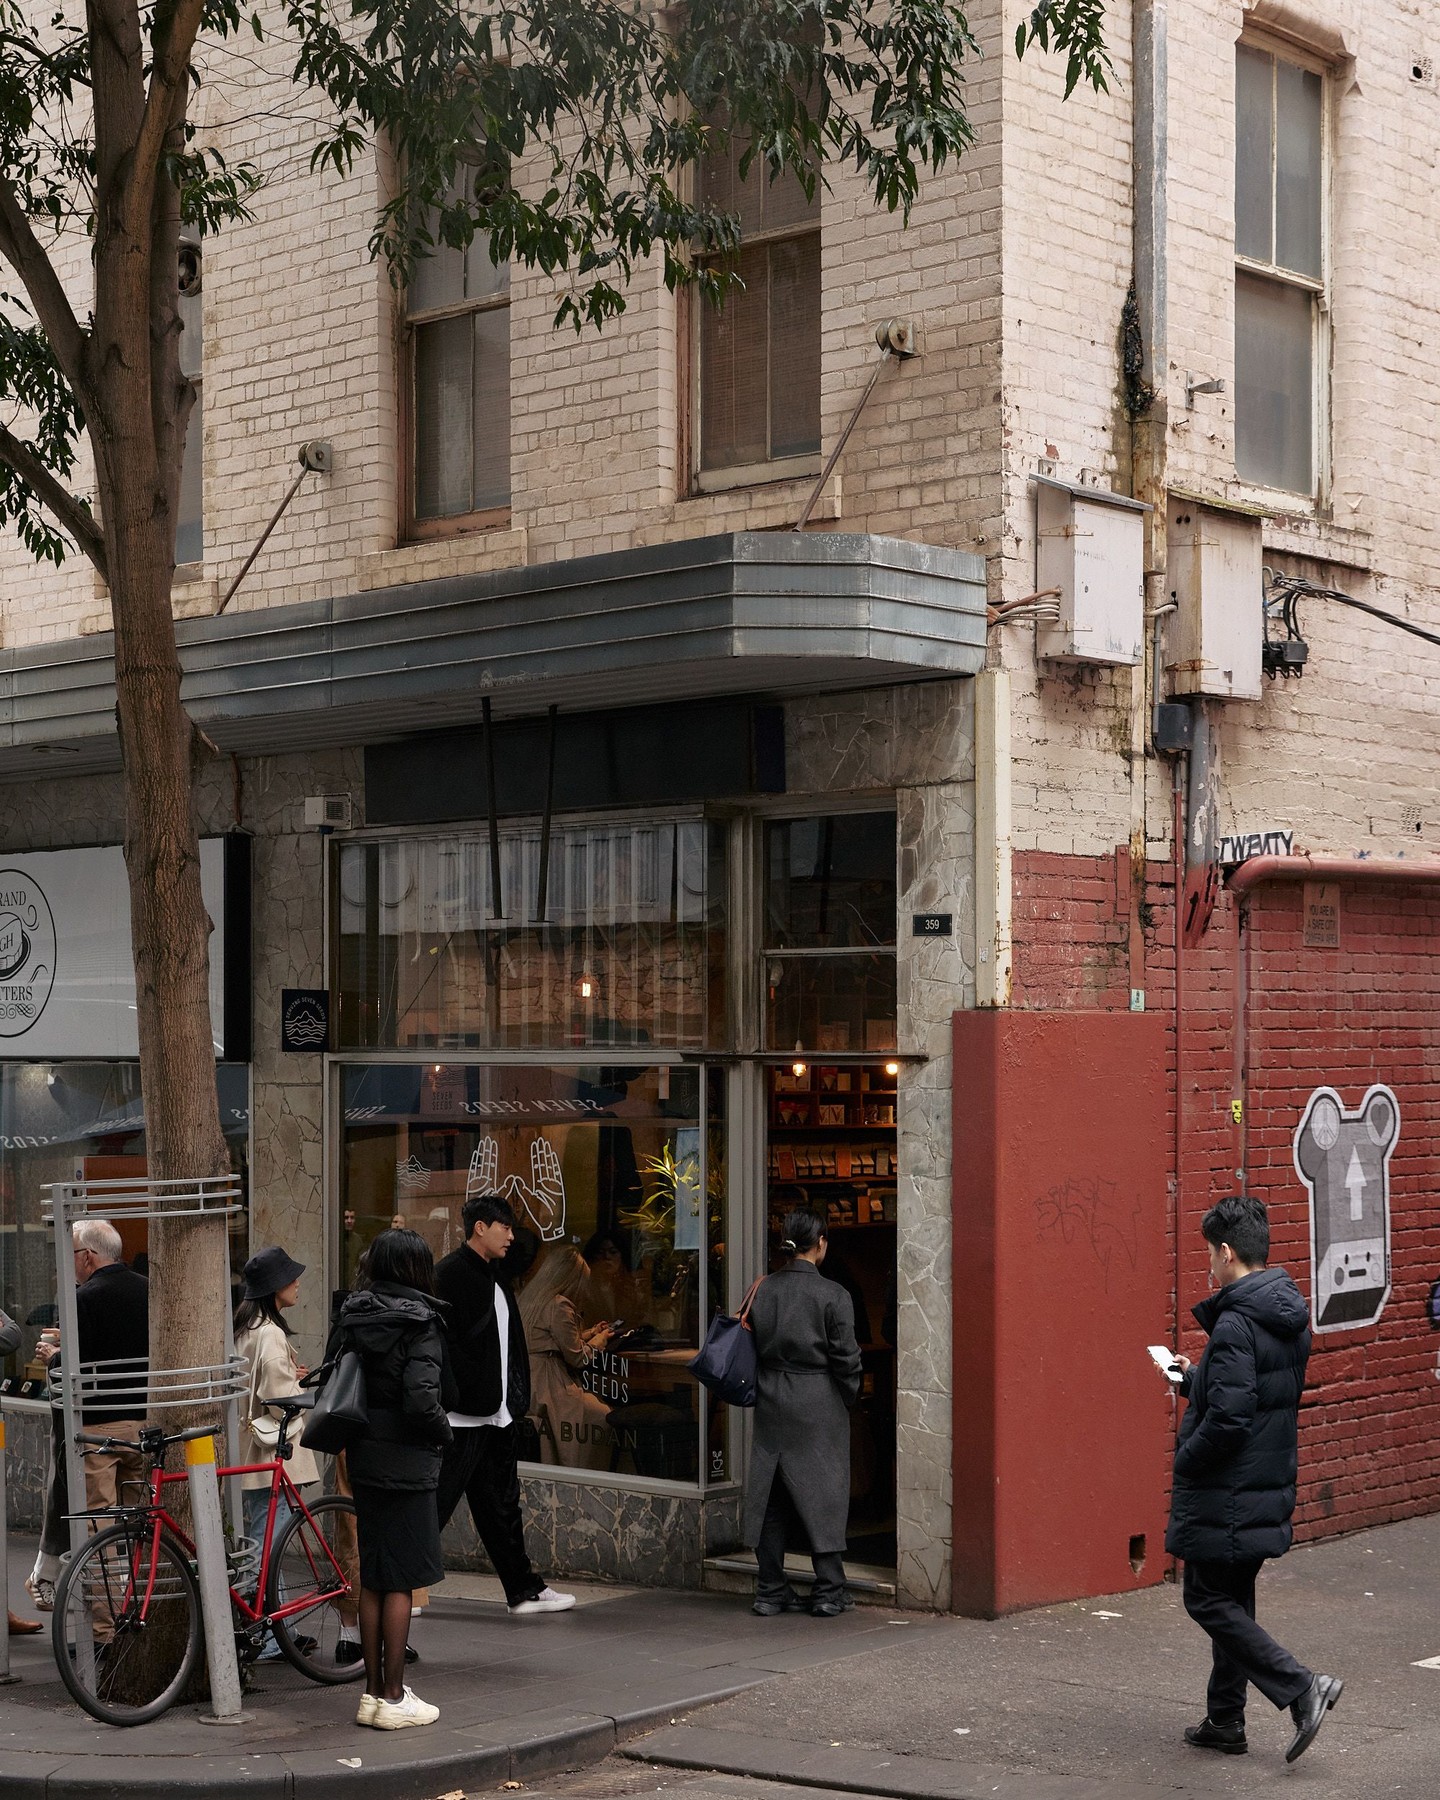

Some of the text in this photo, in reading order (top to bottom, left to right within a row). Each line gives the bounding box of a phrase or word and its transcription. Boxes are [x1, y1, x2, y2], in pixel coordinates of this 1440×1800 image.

[1219, 830, 1294, 862] TWENTY
[924, 919, 940, 930] 359
[301, 996, 316, 1006] SEVEN
[582, 1346, 629, 1379] SEVEN
[582, 1370, 629, 1404] SEEDS
[560, 1420, 638, 1449] BUDAN
